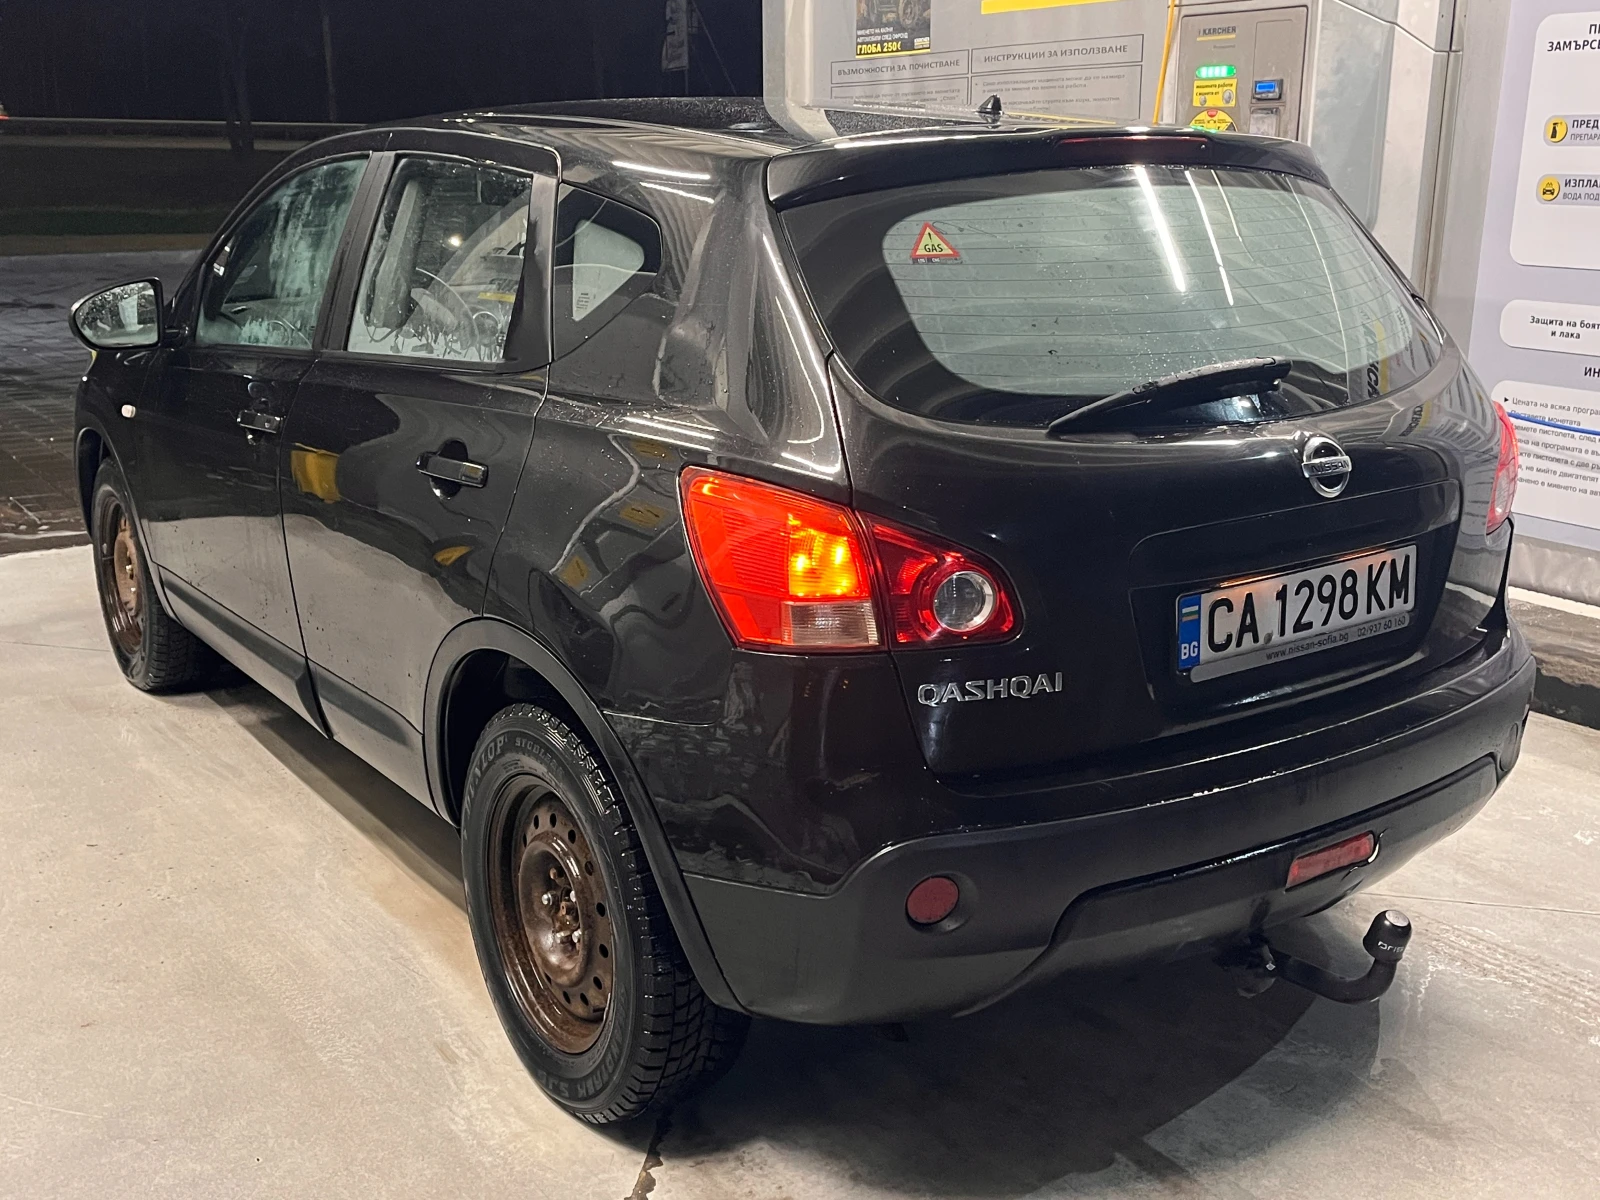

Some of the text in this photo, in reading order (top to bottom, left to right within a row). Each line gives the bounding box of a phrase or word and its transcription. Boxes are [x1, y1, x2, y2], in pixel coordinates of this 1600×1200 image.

[857, 43, 882, 54] ГЛОБА
[984, 45, 1128, 62] ИНСТРУКЦИИ ЗА ИЗПОЛЗВАНЕ
[838, 65, 896, 76] ВЪЗМОЖНОСТИ
[909, 59, 960, 70] ПОЧИСТВАНЕ
[1572, 119, 1599, 130] ПРЕД
[1564, 178, 1600, 188] ИЗПЛА
[1562, 192, 1600, 201] ВОДА ПОД
[924, 244, 944, 253] GAS
[1529, 315, 1563, 327] Защита
[1566, 320, 1577, 328] на
[1559, 331, 1581, 339] лака
[1512, 397, 1538, 407] Цената
[1540, 401, 1549, 409] на
[1550, 403, 1571, 412] всяка
[1513, 423, 1597, 443] земете пистолета, след
[1541, 442, 1583, 454] програмата
[1311, 460, 1350, 473] NISSAN
[1532, 453, 1569, 465] пистолета
[1575, 460, 1590, 468] две
[1536, 467, 1558, 476] мийте
[1558, 471, 1599, 483] двигателят
[1207, 553, 1411, 653] CA 1298 KM
[1383, 619, 1392, 630] 60
[1181, 642, 1199, 660] BG
[1266, 632, 1349, 660] www.nissan-sofia.bg
[917, 672, 1063, 707] QASHQAI
